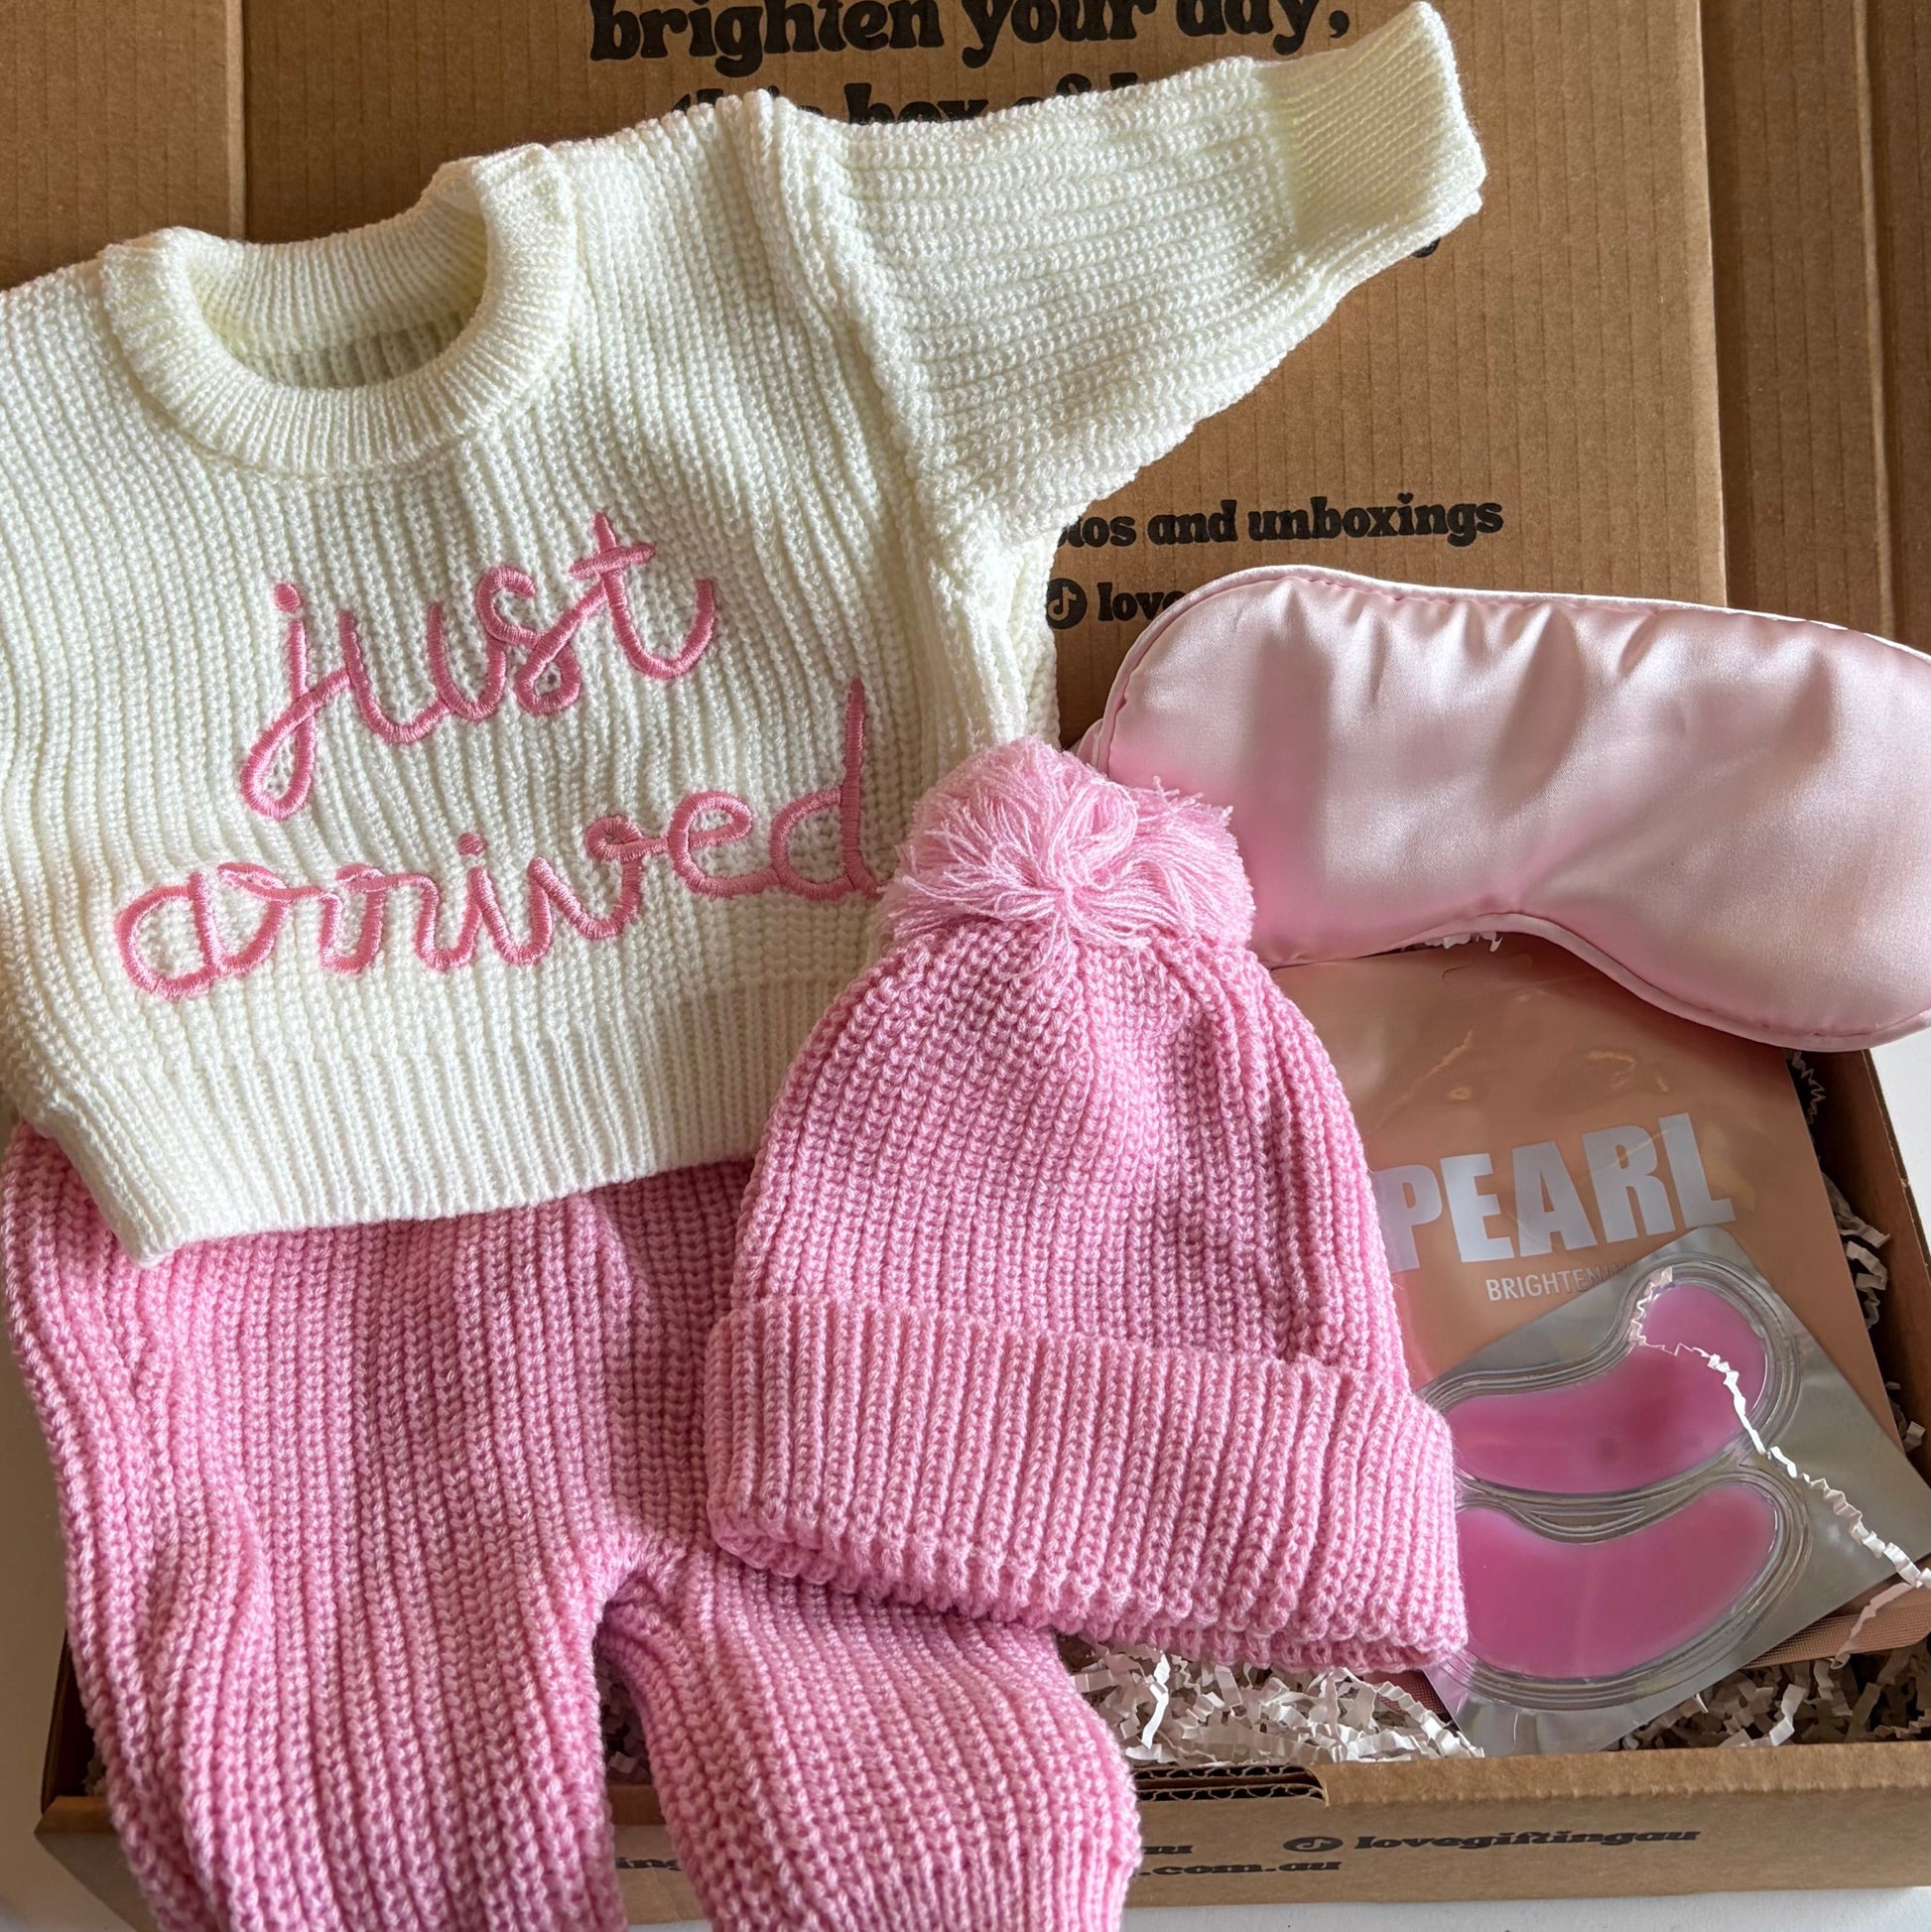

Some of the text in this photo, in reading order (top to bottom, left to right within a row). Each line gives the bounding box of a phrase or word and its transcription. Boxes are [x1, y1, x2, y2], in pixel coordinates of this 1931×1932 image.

[590, 0, 945, 77] brighten
[962, 0, 1156, 68] your
[1057, 493, 1503, 548] tos and unboxings
[240, 512, 714, 820] just
[115, 680, 883, 999] arrived
[1372, 1112, 1737, 1274] PEARL
[1354, 1831, 1702, 1849] lovegiftingau
